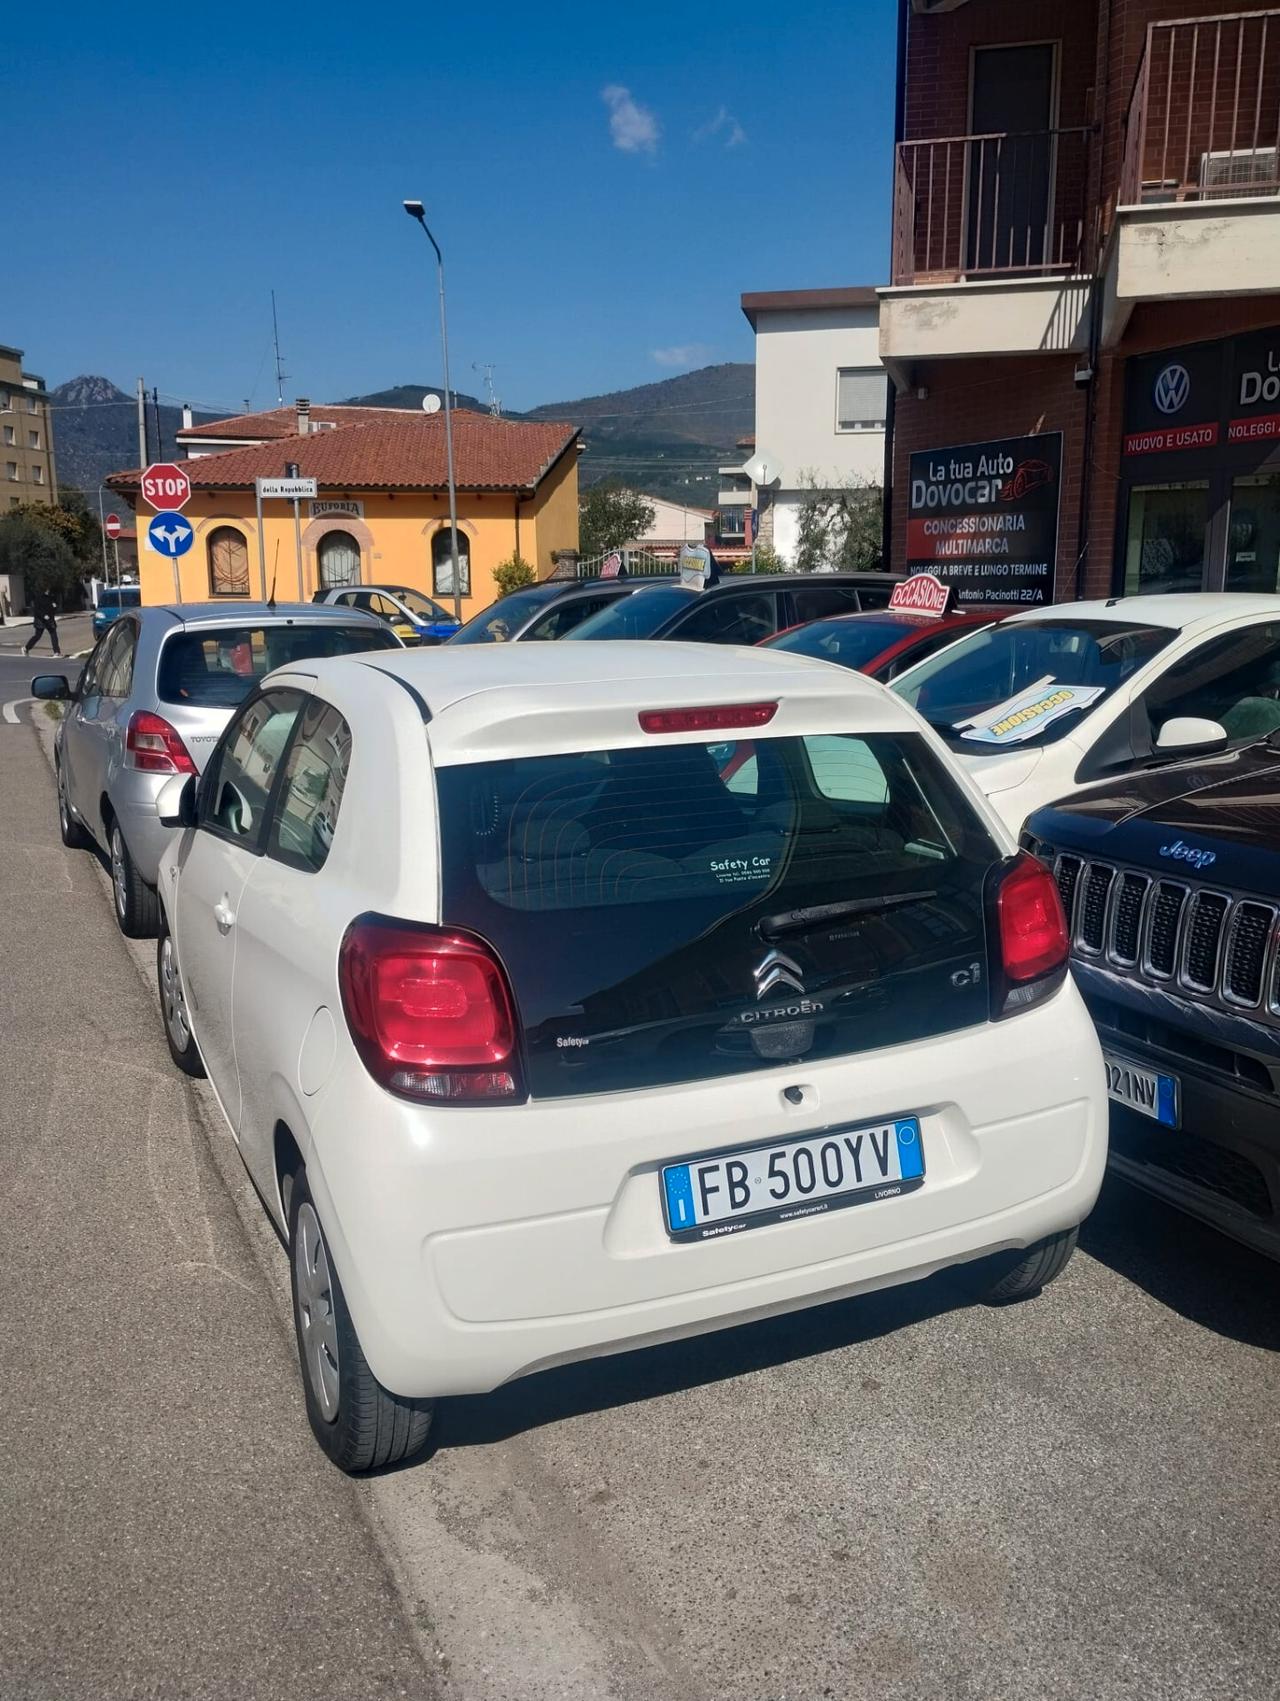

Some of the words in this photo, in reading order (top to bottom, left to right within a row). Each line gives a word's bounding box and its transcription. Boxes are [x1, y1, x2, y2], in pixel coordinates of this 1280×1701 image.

[1268, 351, 1280, 372] L
[1127, 435, 1163, 451] NUOVO
[1166, 434, 1174, 447] E
[1176, 428, 1213, 446] USATO
[1228, 421, 1276, 439] NOLEGGI
[929, 461, 945, 481] La
[950, 459, 973, 479] tua
[977, 452, 1014, 477] Auto
[144, 478, 187, 497] STOP
[262, 485, 278, 493] della
[280, 485, 313, 494] Repubblica
[911, 478, 1003, 510] Dovocar
[312, 502, 361, 516] EUFORIA
[923, 514, 1025, 536] CONCESSIONARIA
[935, 537, 1009, 556] MULTIMARCA
[942, 565, 948, 576] A
[949, 564, 973, 576] BREVE
[974, 564, 980, 576] E
[981, 563, 1009, 576] LUNGO
[1010, 563, 1048, 576] TERMINE
[893, 579, 946, 610] OCCASIONE
[985, 588, 1020, 601] Pacinotti
[1020, 588, 1044, 601] 22/A
[990, 690, 1075, 737] OCCASIONE
[710, 858, 748, 871] Safety
[752, 856, 771, 866] Car
[1159, 840, 1216, 869] Jeep
[697, 1160, 751, 1216] FB
[767, 1129, 890, 1200] 500YV
[874, 1187, 902, 1199] LIVORNO
[702, 1222, 748, 1237] Safetycar
